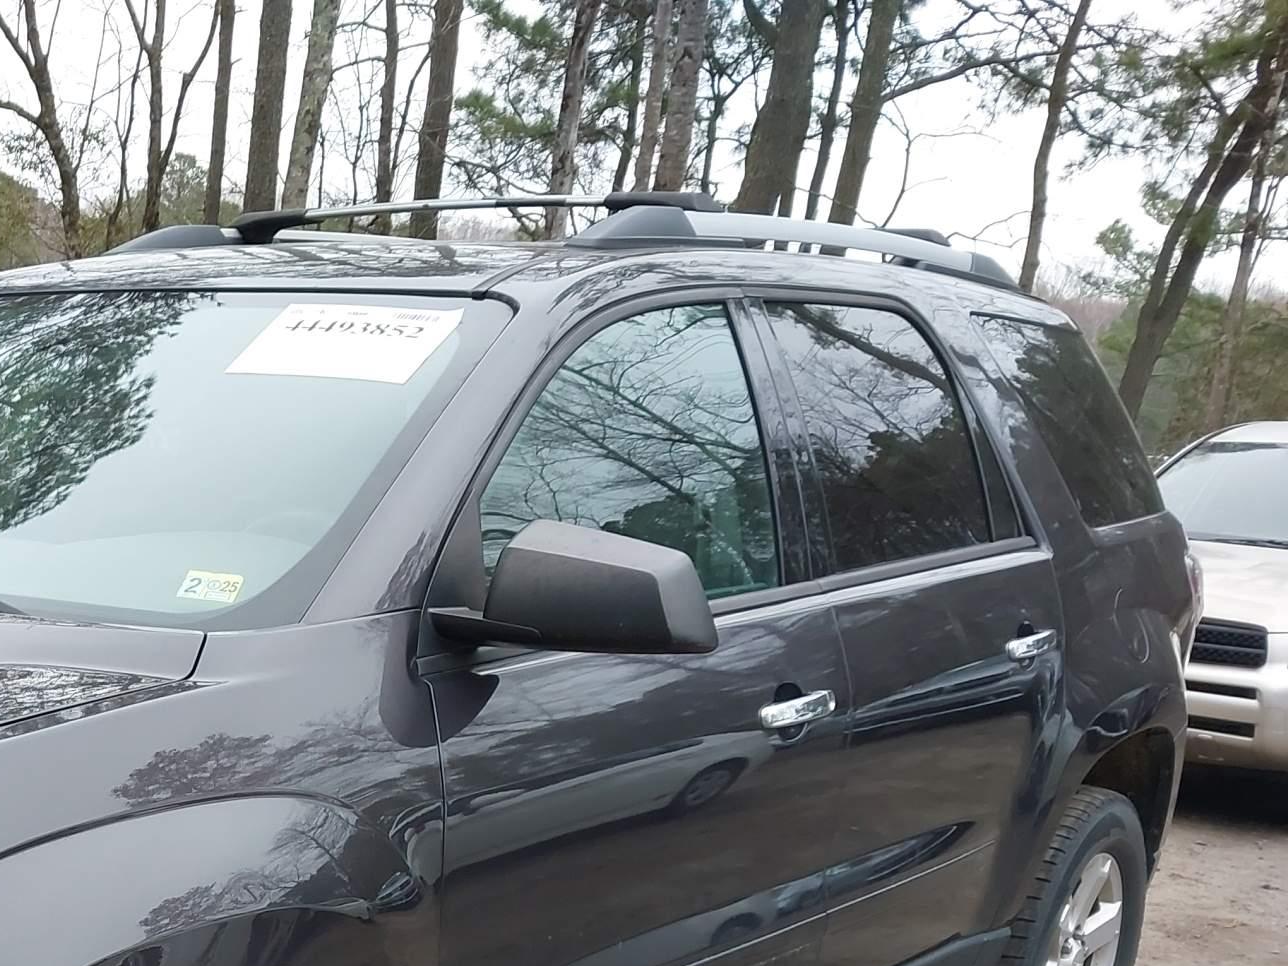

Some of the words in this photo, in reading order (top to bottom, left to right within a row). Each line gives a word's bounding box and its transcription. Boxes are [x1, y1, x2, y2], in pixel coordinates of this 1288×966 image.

[285, 319, 424, 339] 44493852
[184, 577, 202, 593] 2
[220, 581, 240, 593] 25
